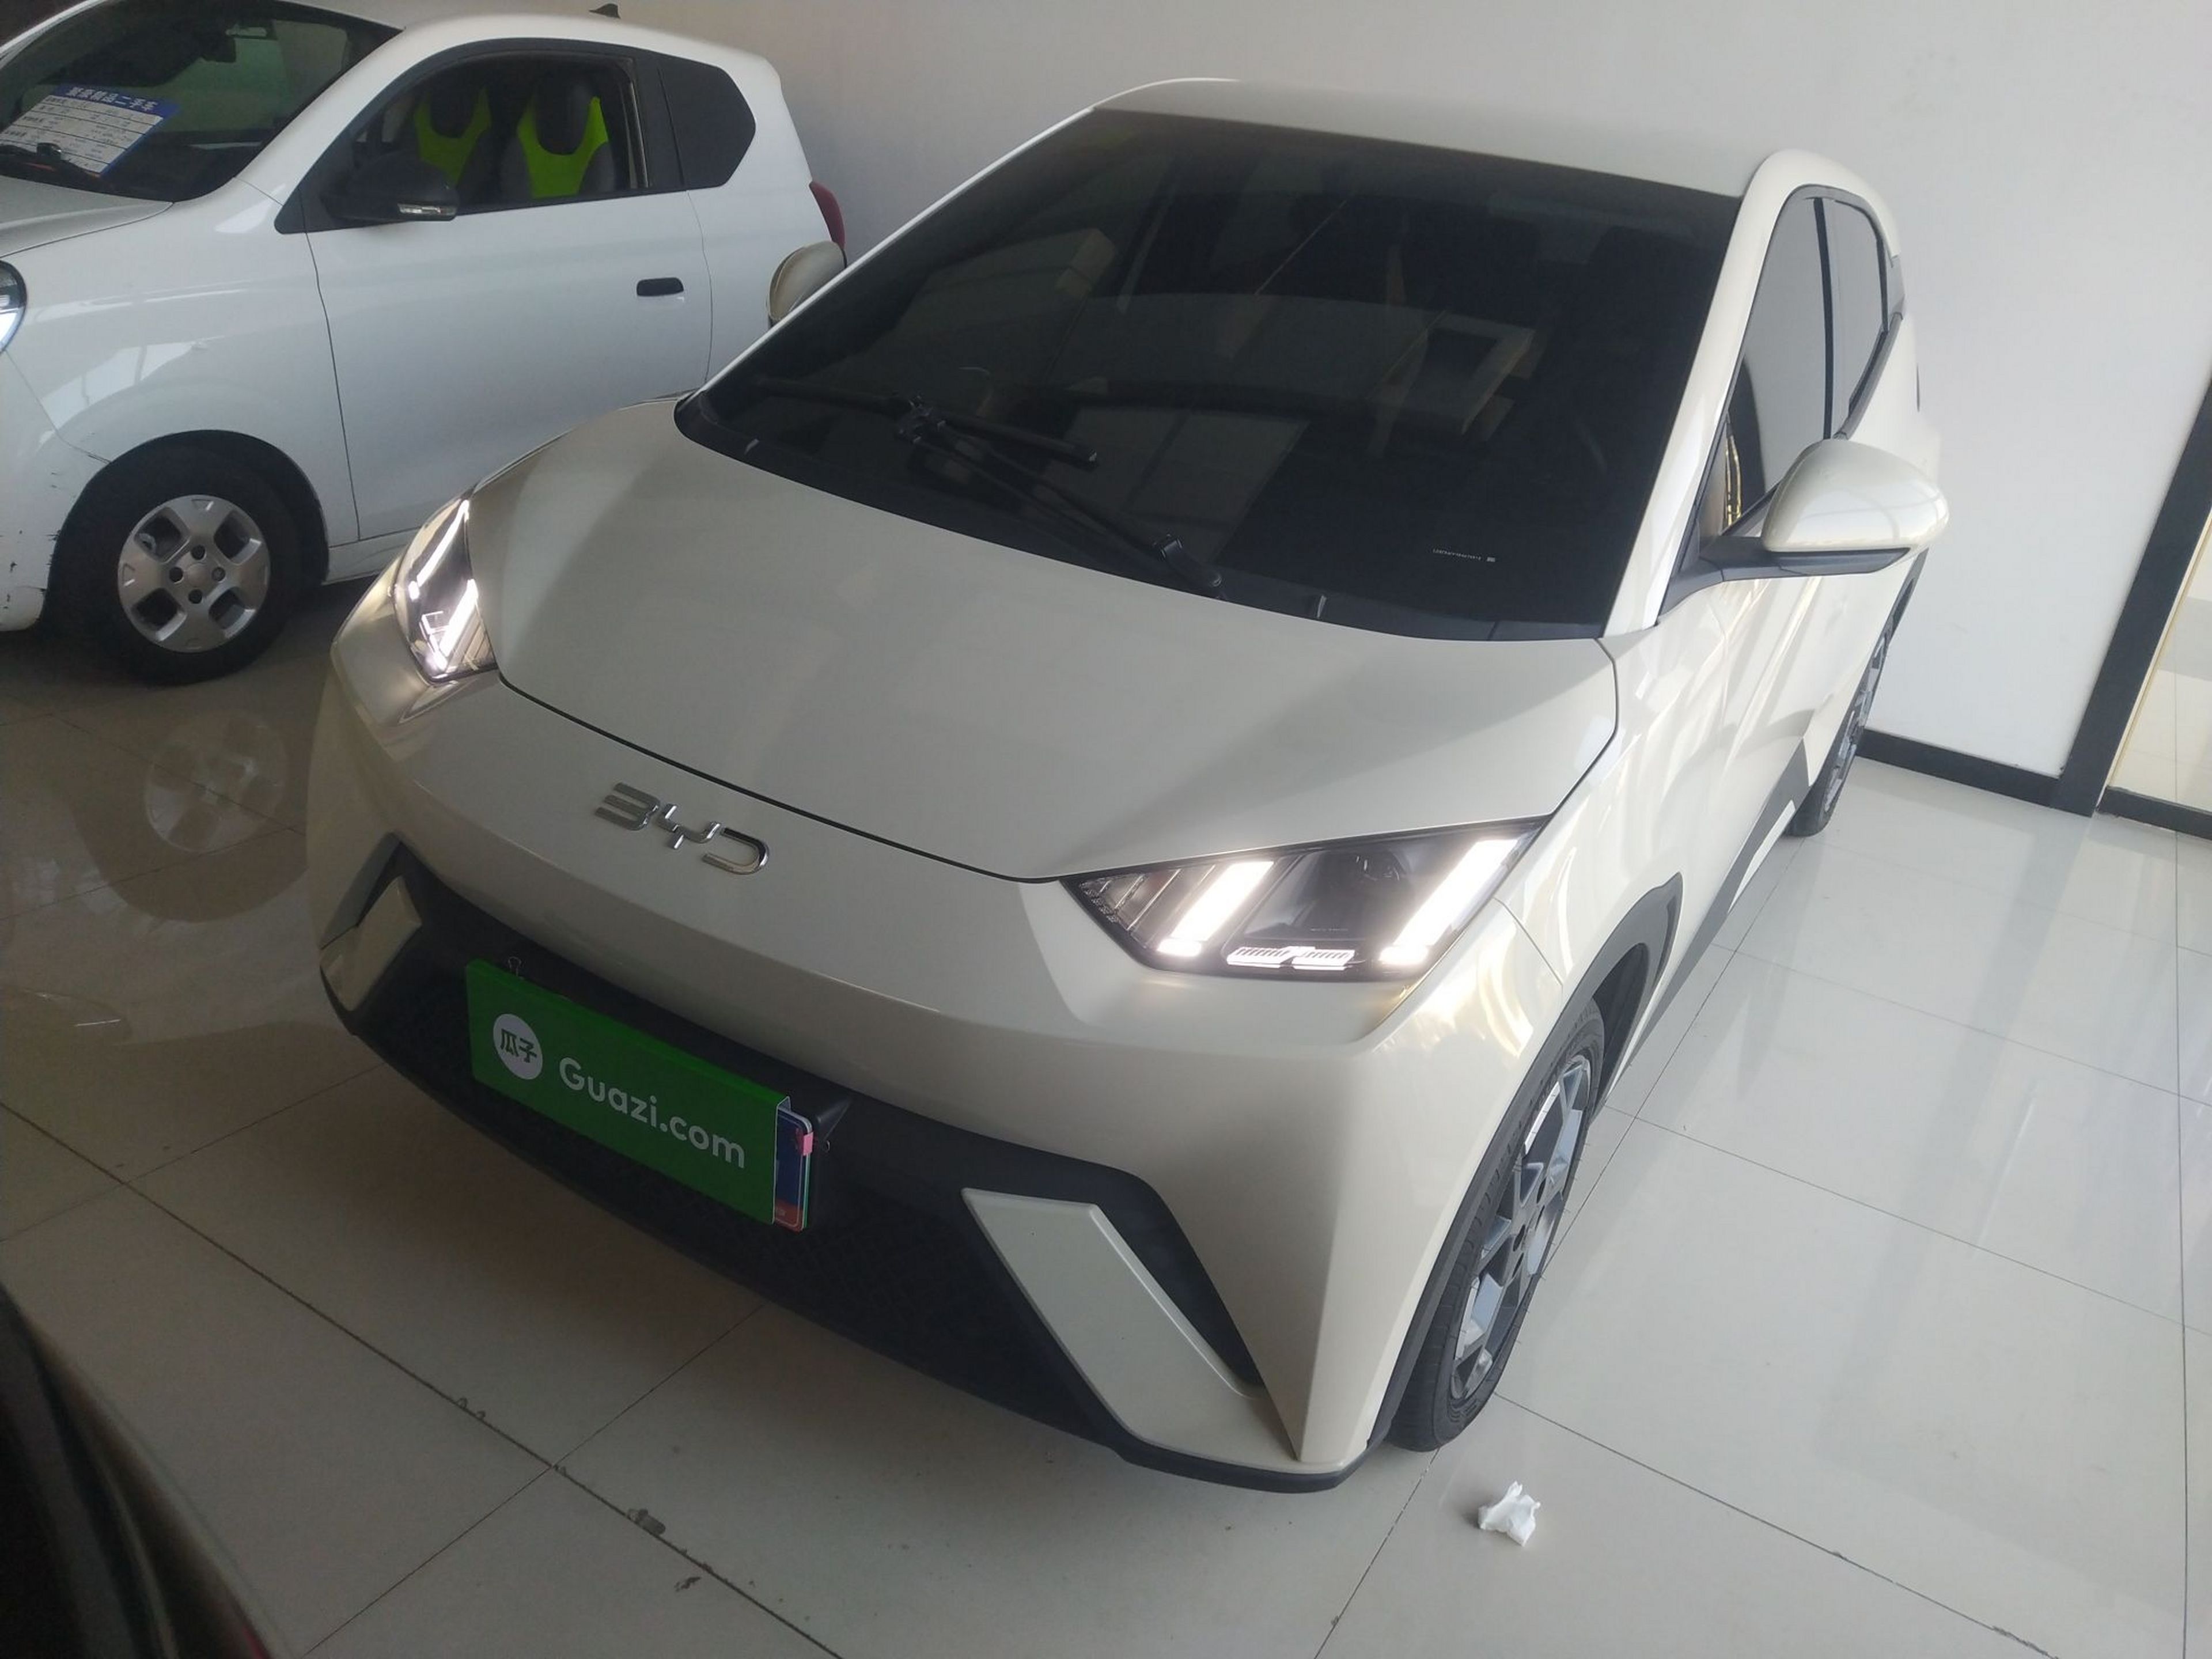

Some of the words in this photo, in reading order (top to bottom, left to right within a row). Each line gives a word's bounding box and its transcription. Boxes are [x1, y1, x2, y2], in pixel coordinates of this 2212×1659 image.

[594, 782, 769, 874] BYD
[499, 1029, 537, 1064] 瓜子
[559, 1058, 745, 1168] Guazi.com
